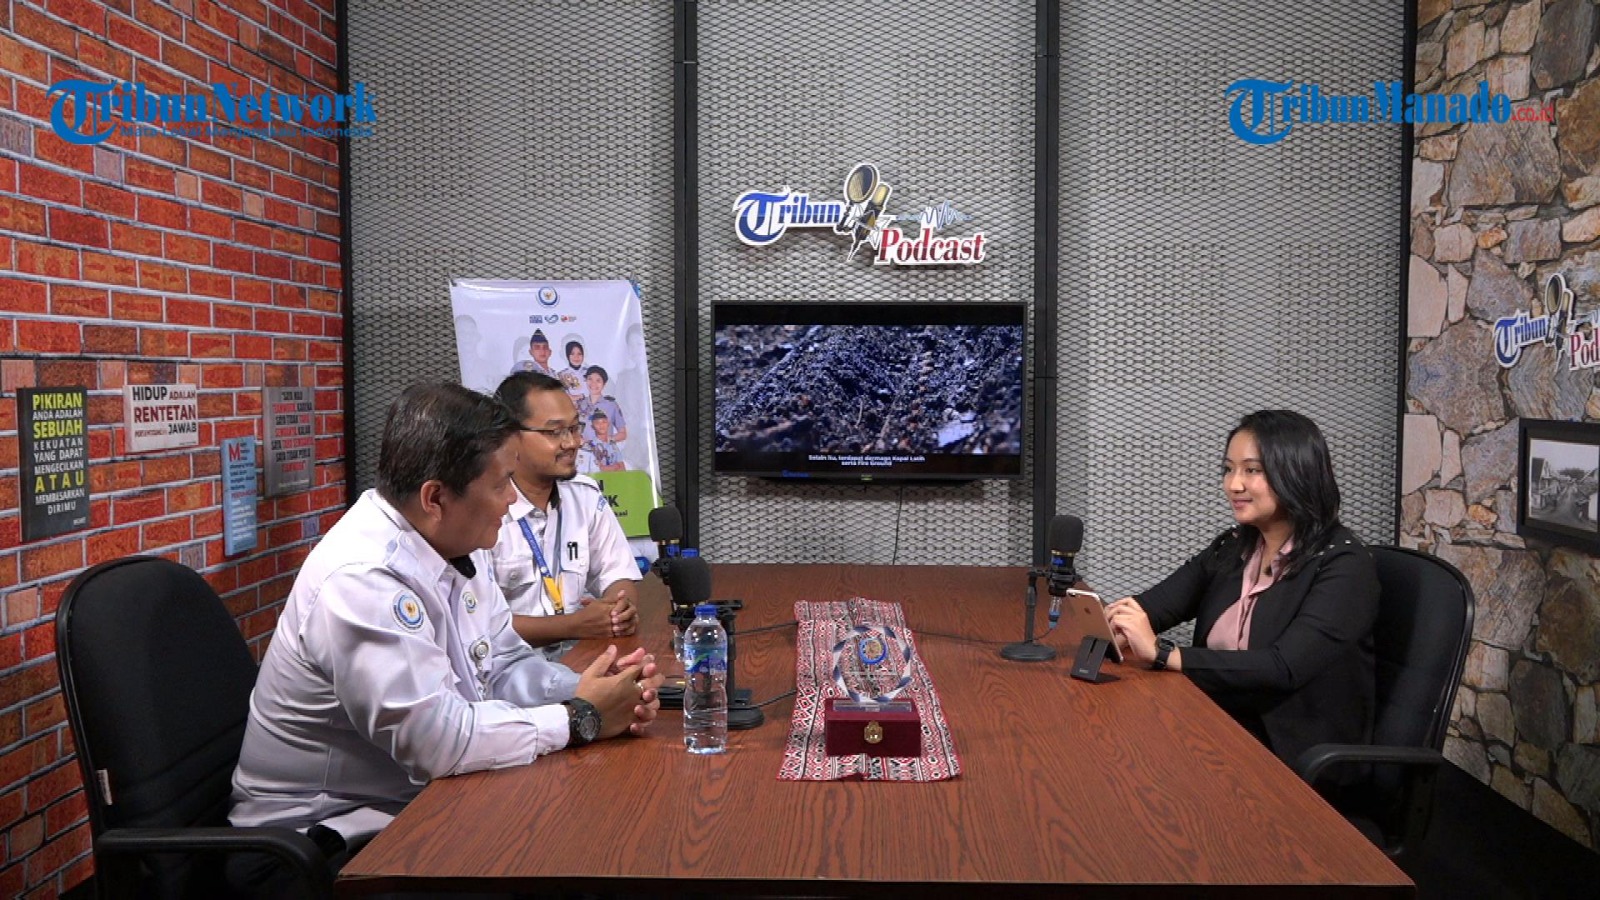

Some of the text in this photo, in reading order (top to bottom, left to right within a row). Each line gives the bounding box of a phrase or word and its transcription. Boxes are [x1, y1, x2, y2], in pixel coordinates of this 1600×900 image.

[737, 193, 841, 242] Tribun
[878, 228, 984, 261] Podcast
[1495, 316, 1546, 364] Tribun
[32, 392, 83, 410] PIKIRAN
[132, 386, 196, 401] HIDUP ADALAH
[32, 408, 83, 420] ANDA ADALAH
[134, 404, 196, 423] RENTETAN
[33, 419, 83, 439] SEBUAH
[168, 422, 197, 435] JAWAB
[33, 437, 83, 451] KEKUATAN
[33, 447, 84, 463] YANG DAPAT
[34, 460, 84, 475] MENGECILKAN
[34, 470, 84, 494] ATAU
[35, 487, 85, 505] MEMBESARKAN
[47, 501, 76, 516] DIRIMU
